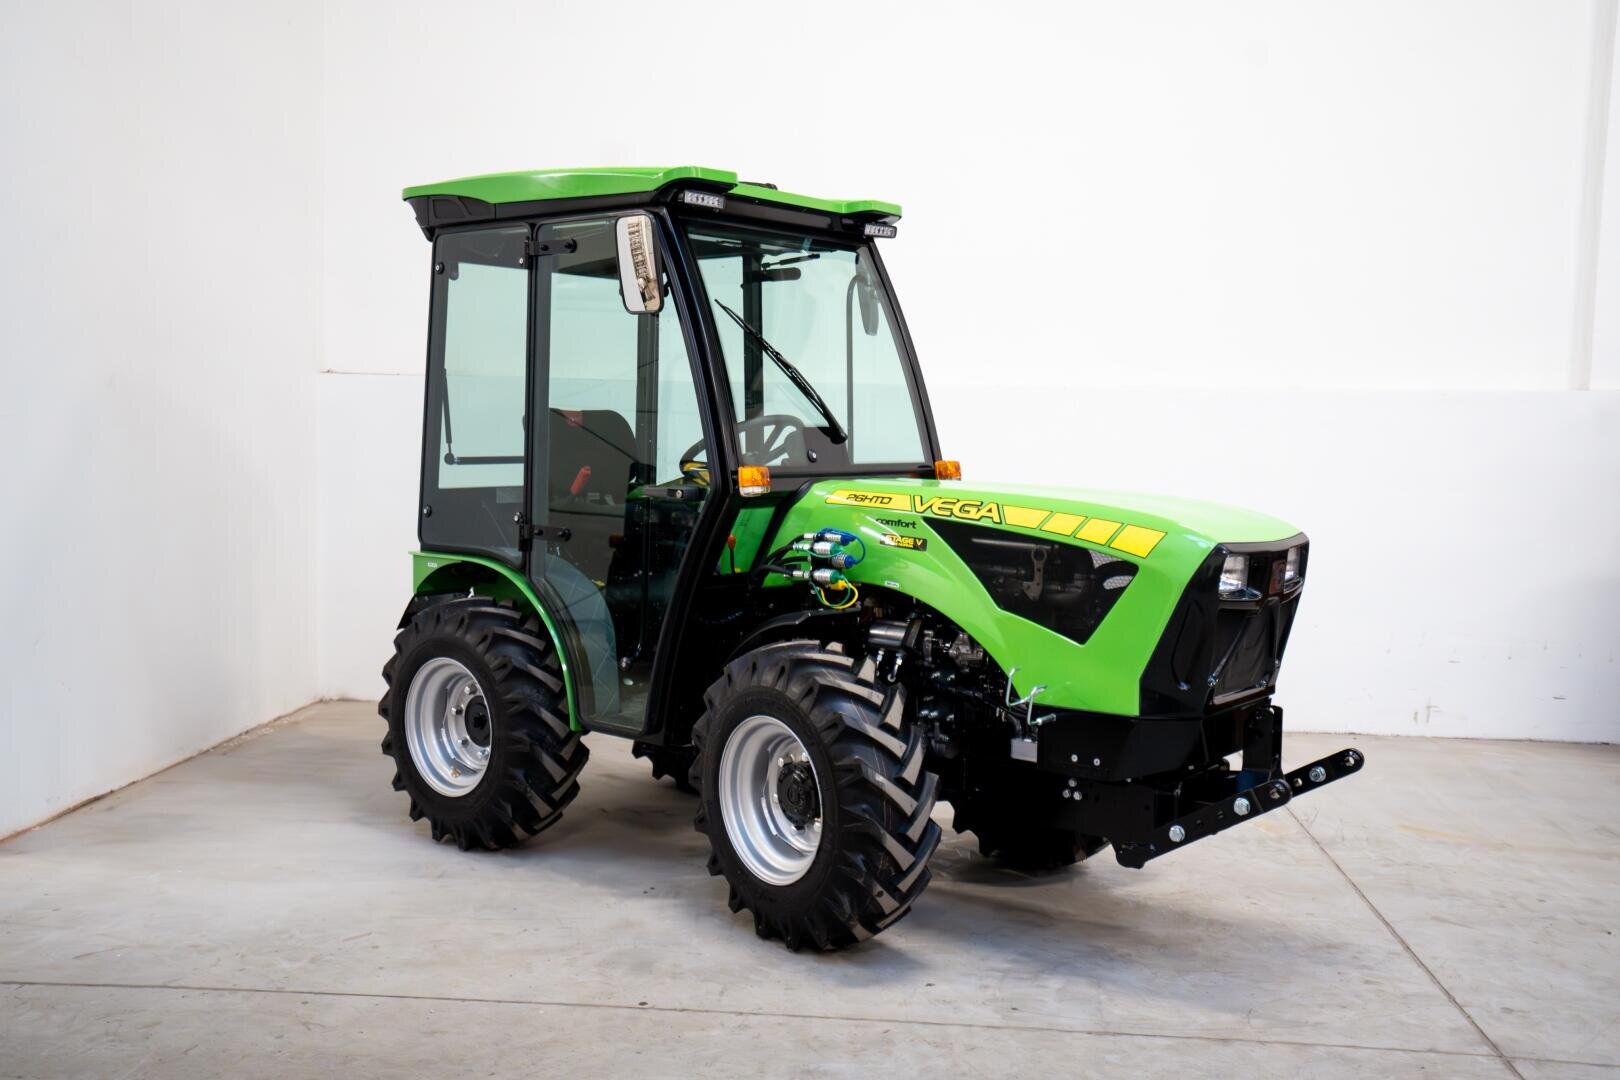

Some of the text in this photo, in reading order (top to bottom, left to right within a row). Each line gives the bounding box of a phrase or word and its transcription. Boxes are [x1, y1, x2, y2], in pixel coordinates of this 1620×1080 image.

[914, 494, 1002, 524] VEGA
[876, 518, 917, 529] comfort
[916, 538, 923, 546] V
